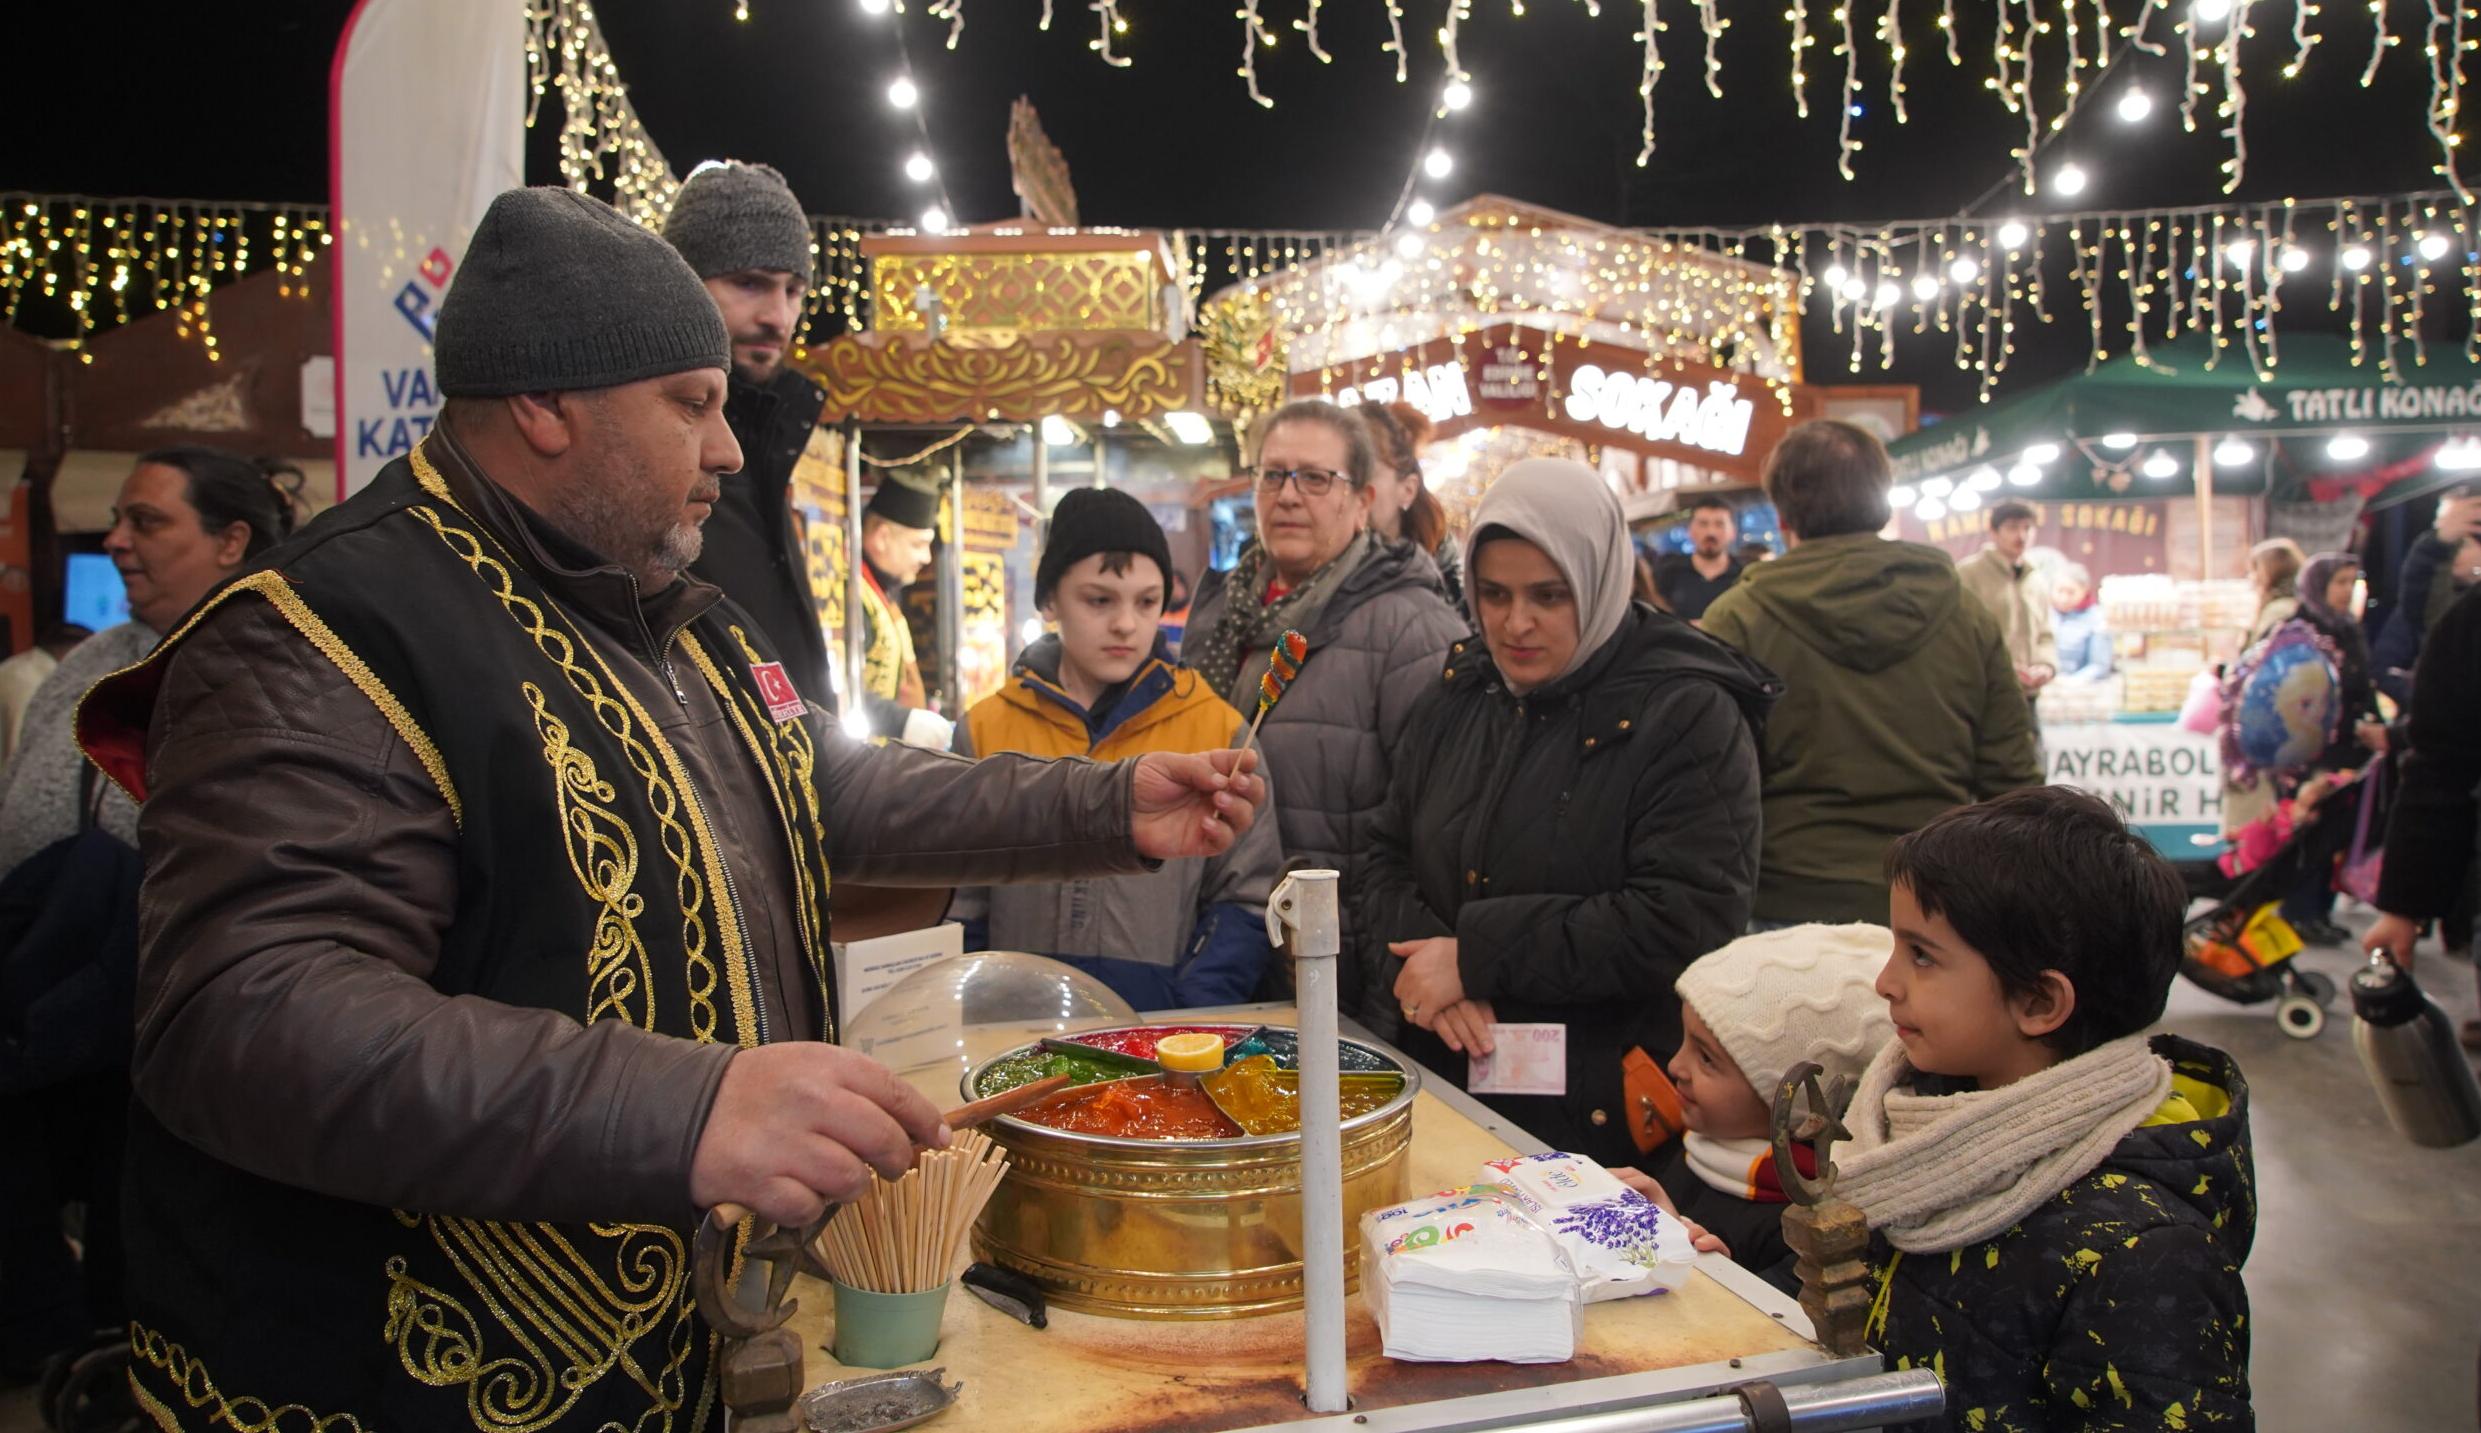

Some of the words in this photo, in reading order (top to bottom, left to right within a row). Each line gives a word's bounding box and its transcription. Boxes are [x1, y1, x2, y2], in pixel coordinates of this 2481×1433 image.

[382, 368, 439, 408] VA
[2287, 387, 2376, 422] TATLI
[2379, 377, 2481, 420] KONAĞ
[1565, 365, 1753, 455] SOKAĞI
[2061, 502, 2159, 537] SOKAĞI
[2044, 747, 2216, 778] AYRABOL
[1532, 1028, 1561, 1042] 200
